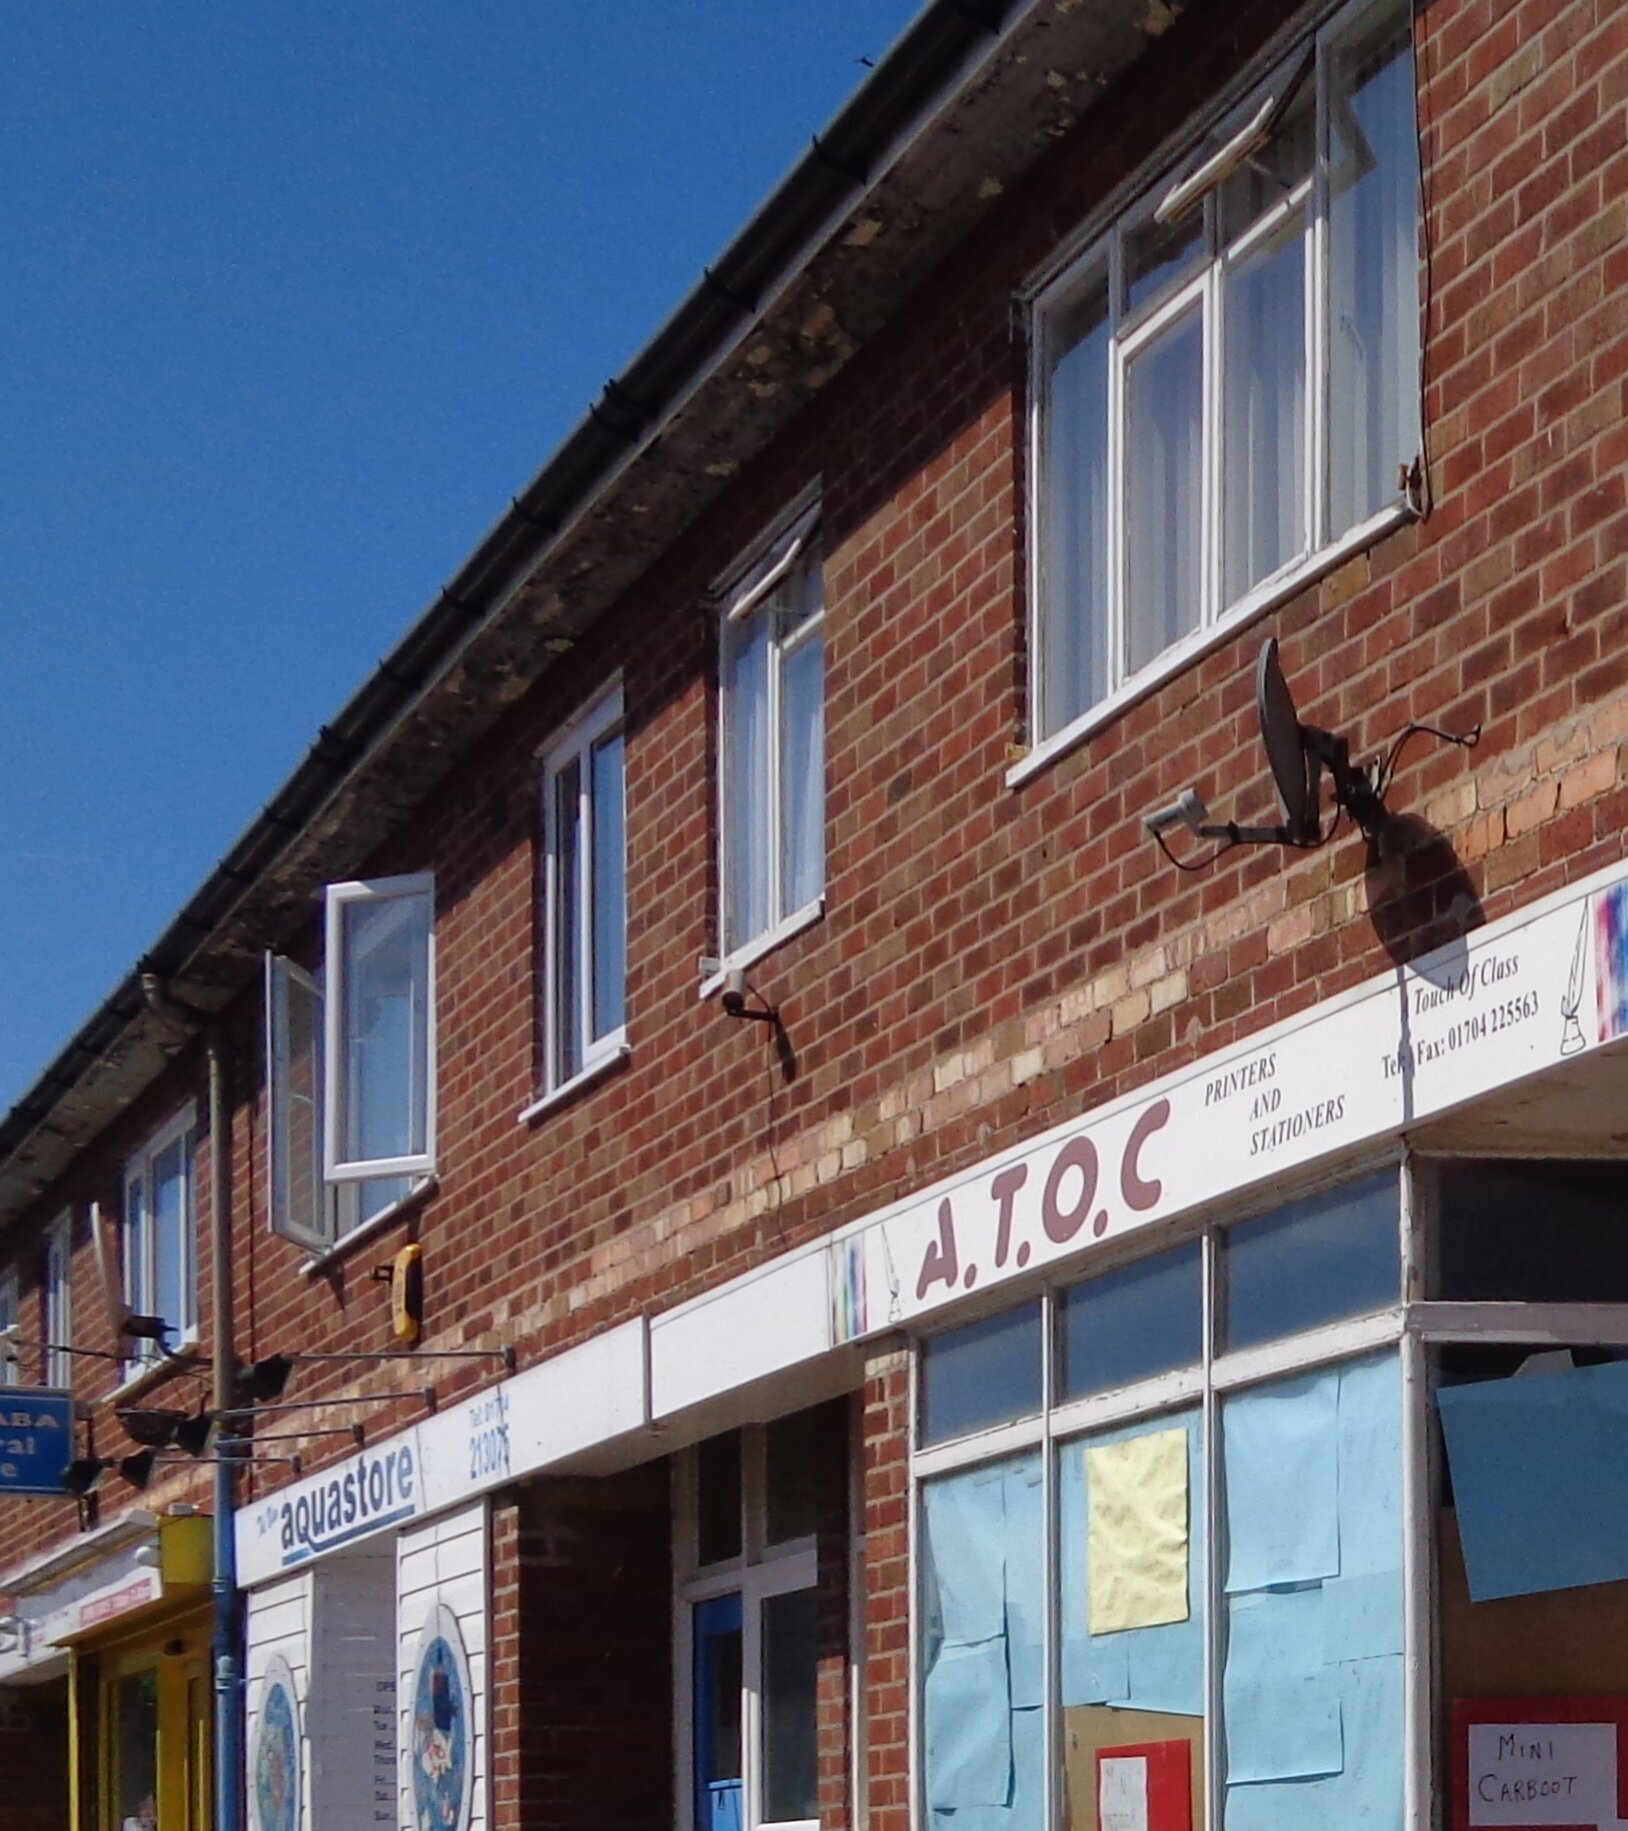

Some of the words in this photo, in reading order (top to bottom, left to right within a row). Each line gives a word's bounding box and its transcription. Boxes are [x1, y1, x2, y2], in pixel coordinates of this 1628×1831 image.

[1415, 976, 1454, 1015] Touch
[1459, 963, 1479, 1001] Of
[1481, 956, 1519, 986] Class
[1417, 1039, 1445, 1065] Fax:
[1448, 1012, 1487, 1051] 01704
[1491, 990, 1539, 1033] 225563
[1203, 1053, 1277, 1108] PRINTERS
[1248, 1088, 1282, 1123] AND
[1248, 1095, 1345, 1157] STATIONERS
[914, 1098, 1172, 1302] A.T.O.C
[280, 1446, 413, 1552] aquastore
[1497, 1734, 1554, 1761] MINI
[1477, 1774, 1578, 1803] CARBOOT
